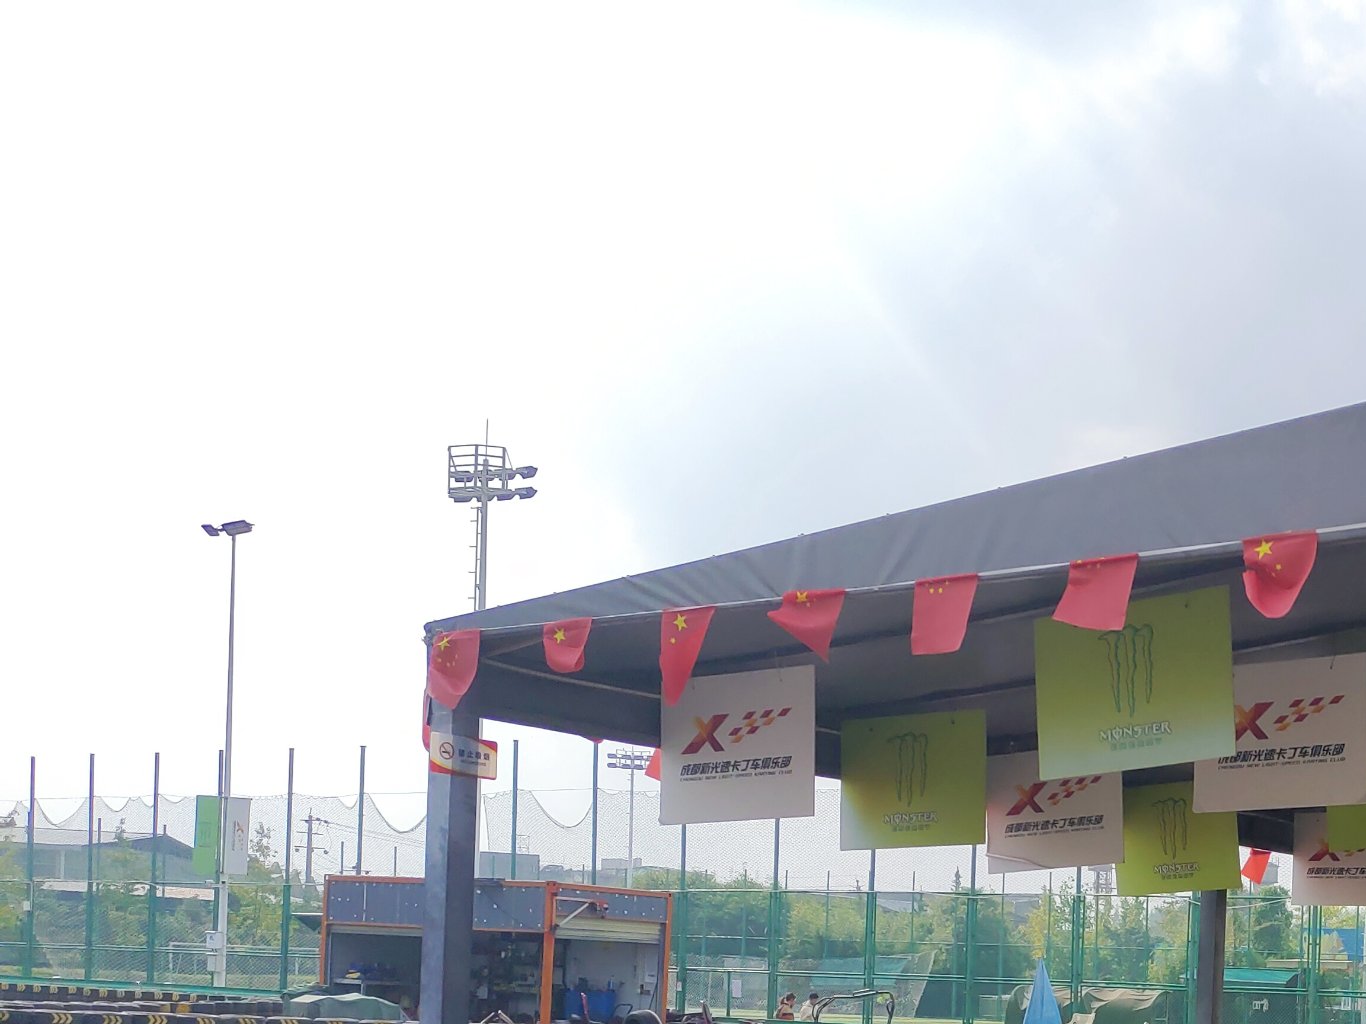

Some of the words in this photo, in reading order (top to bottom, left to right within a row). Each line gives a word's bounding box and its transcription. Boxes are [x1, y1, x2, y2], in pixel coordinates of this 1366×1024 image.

[1099, 721, 1172, 743] MONSTER
[680, 756, 793, 776] 成都新光速卡丁车俱乐部
[883, 812, 938, 824] MONSTER
[1153, 862, 1201, 874] MONSTER
